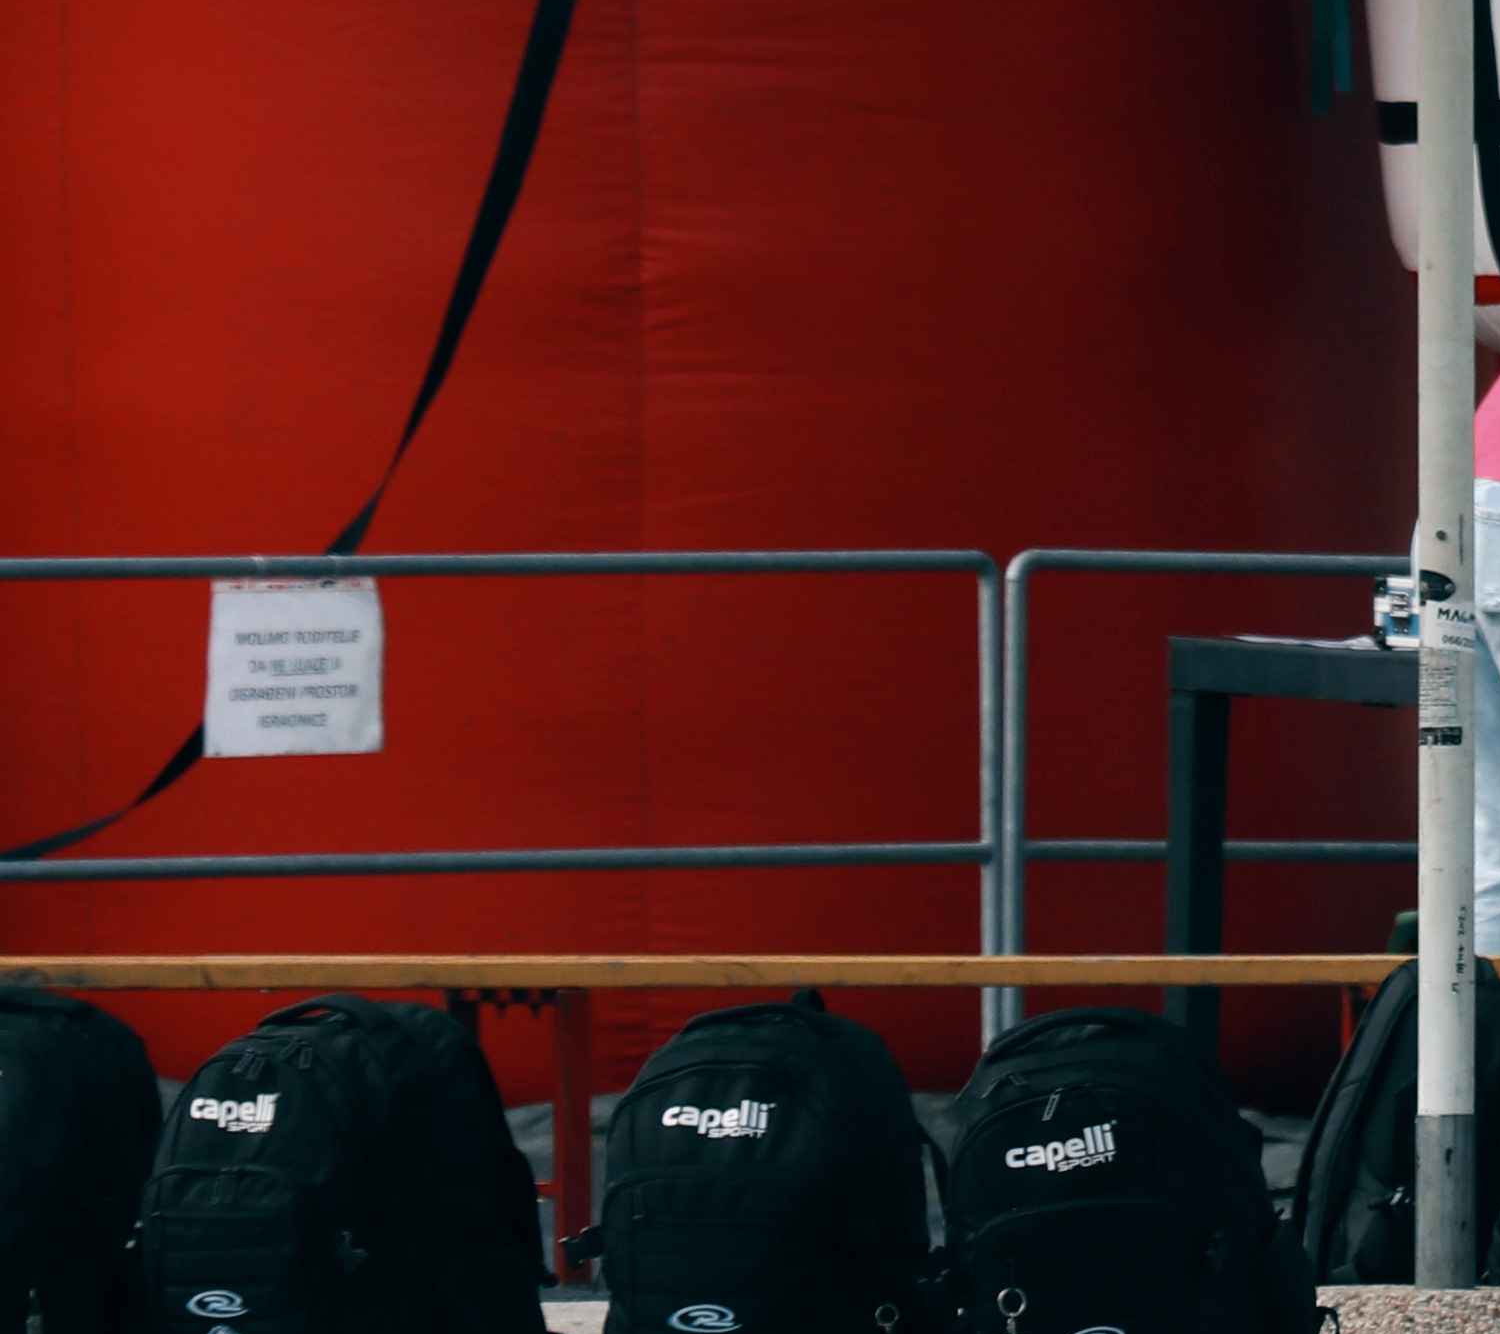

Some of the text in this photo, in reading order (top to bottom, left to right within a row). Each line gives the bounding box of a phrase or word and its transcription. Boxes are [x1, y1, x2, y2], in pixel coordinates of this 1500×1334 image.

[190, 1093, 277, 1128] capelli
[661, 1099, 769, 1135] capelli
[707, 1127, 767, 1139] SPORT
[1005, 1122, 1116, 1172] capelli
[1057, 1152, 1117, 1173] SPORT
